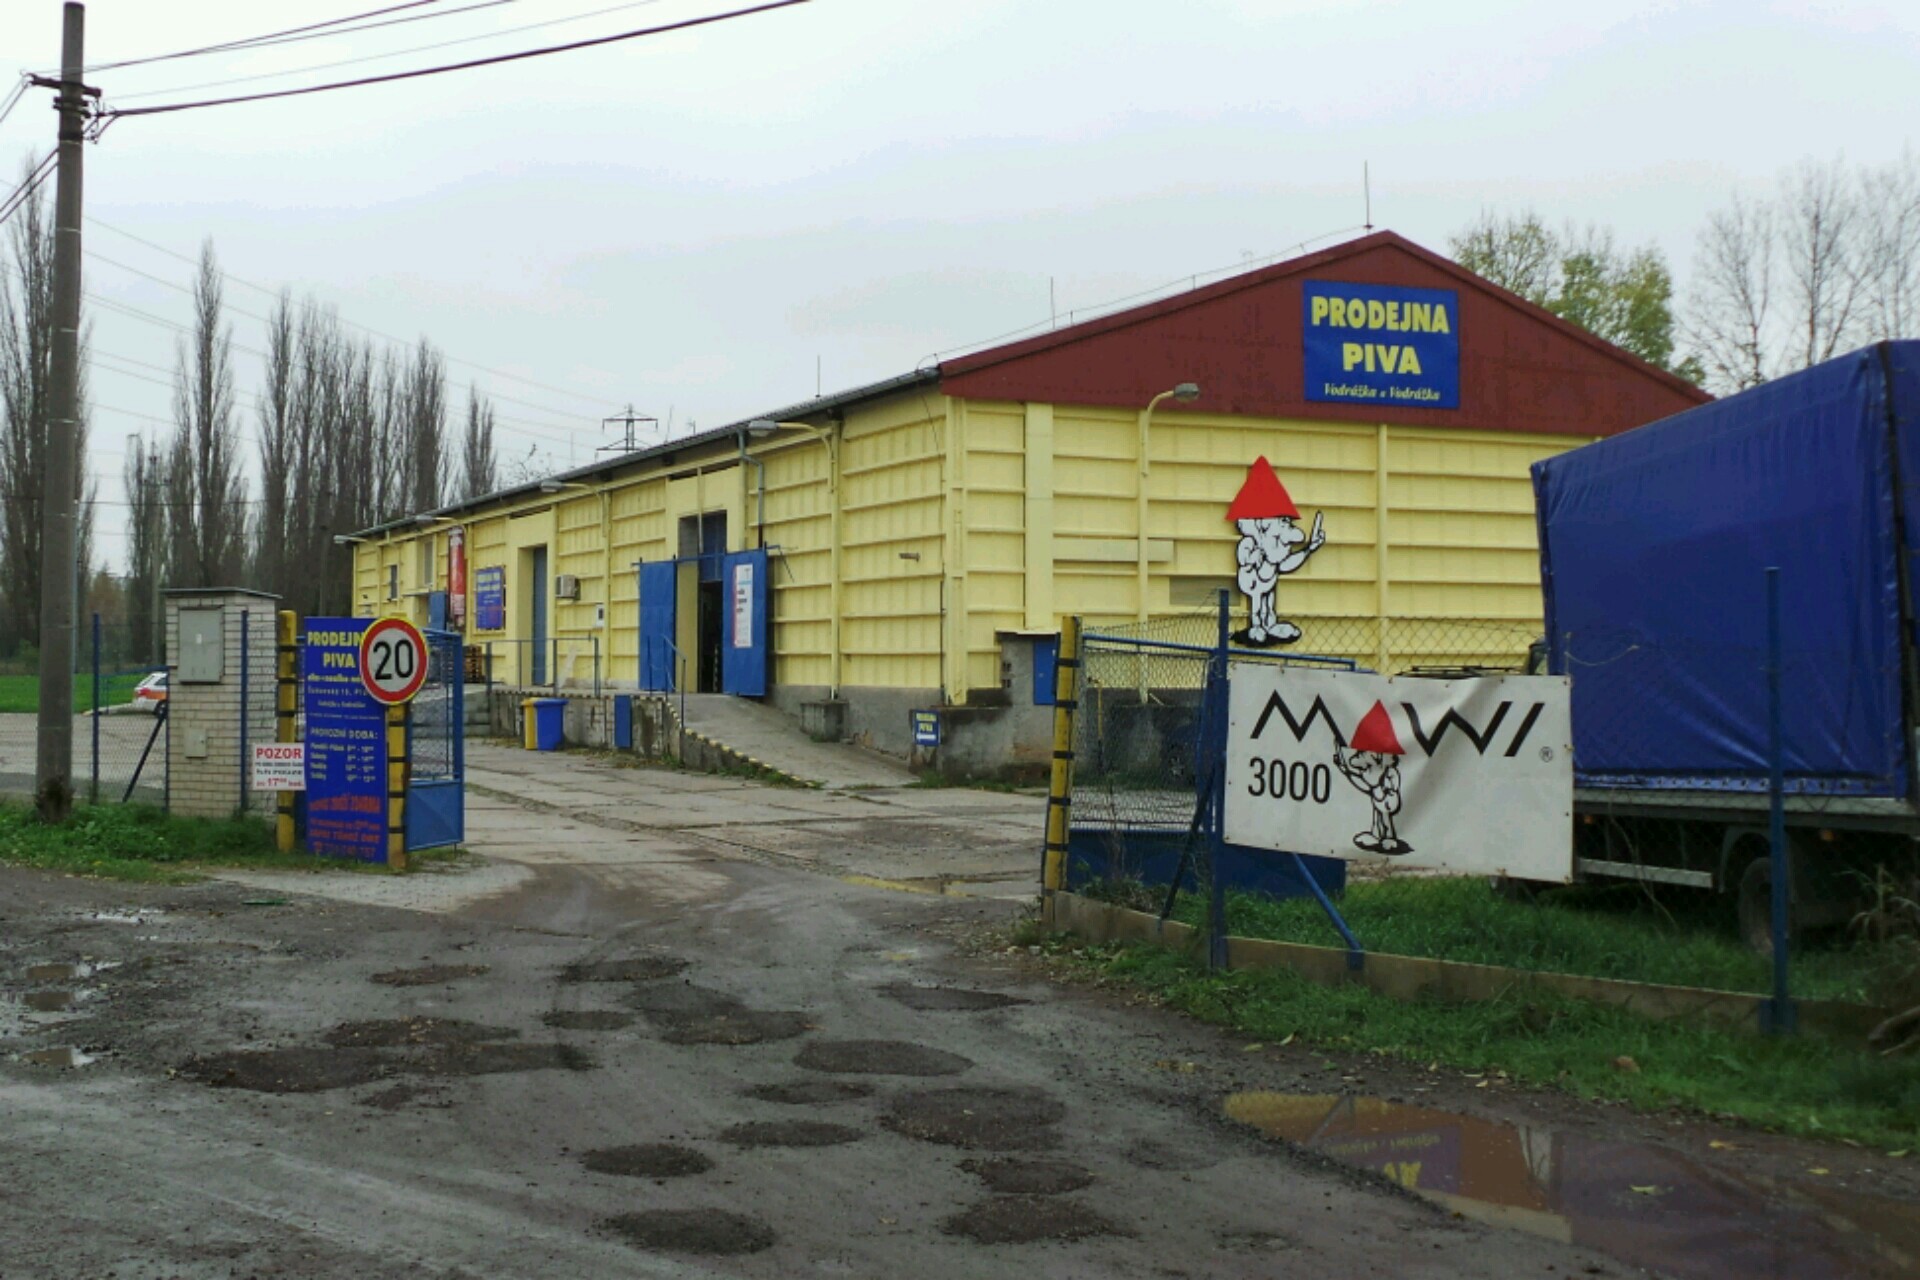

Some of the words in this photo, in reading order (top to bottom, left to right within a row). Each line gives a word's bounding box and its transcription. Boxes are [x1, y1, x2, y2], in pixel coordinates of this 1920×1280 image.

[1311, 296, 1450, 334] PRODEJNA
[1343, 343, 1422, 375] PIVA
[307, 631, 362, 647] PRODEJN
[323, 653, 356, 668] PIVA
[373, 639, 414, 680] 20
[255, 747, 302, 759] POZOR
[1248, 757, 1331, 804] 3000
